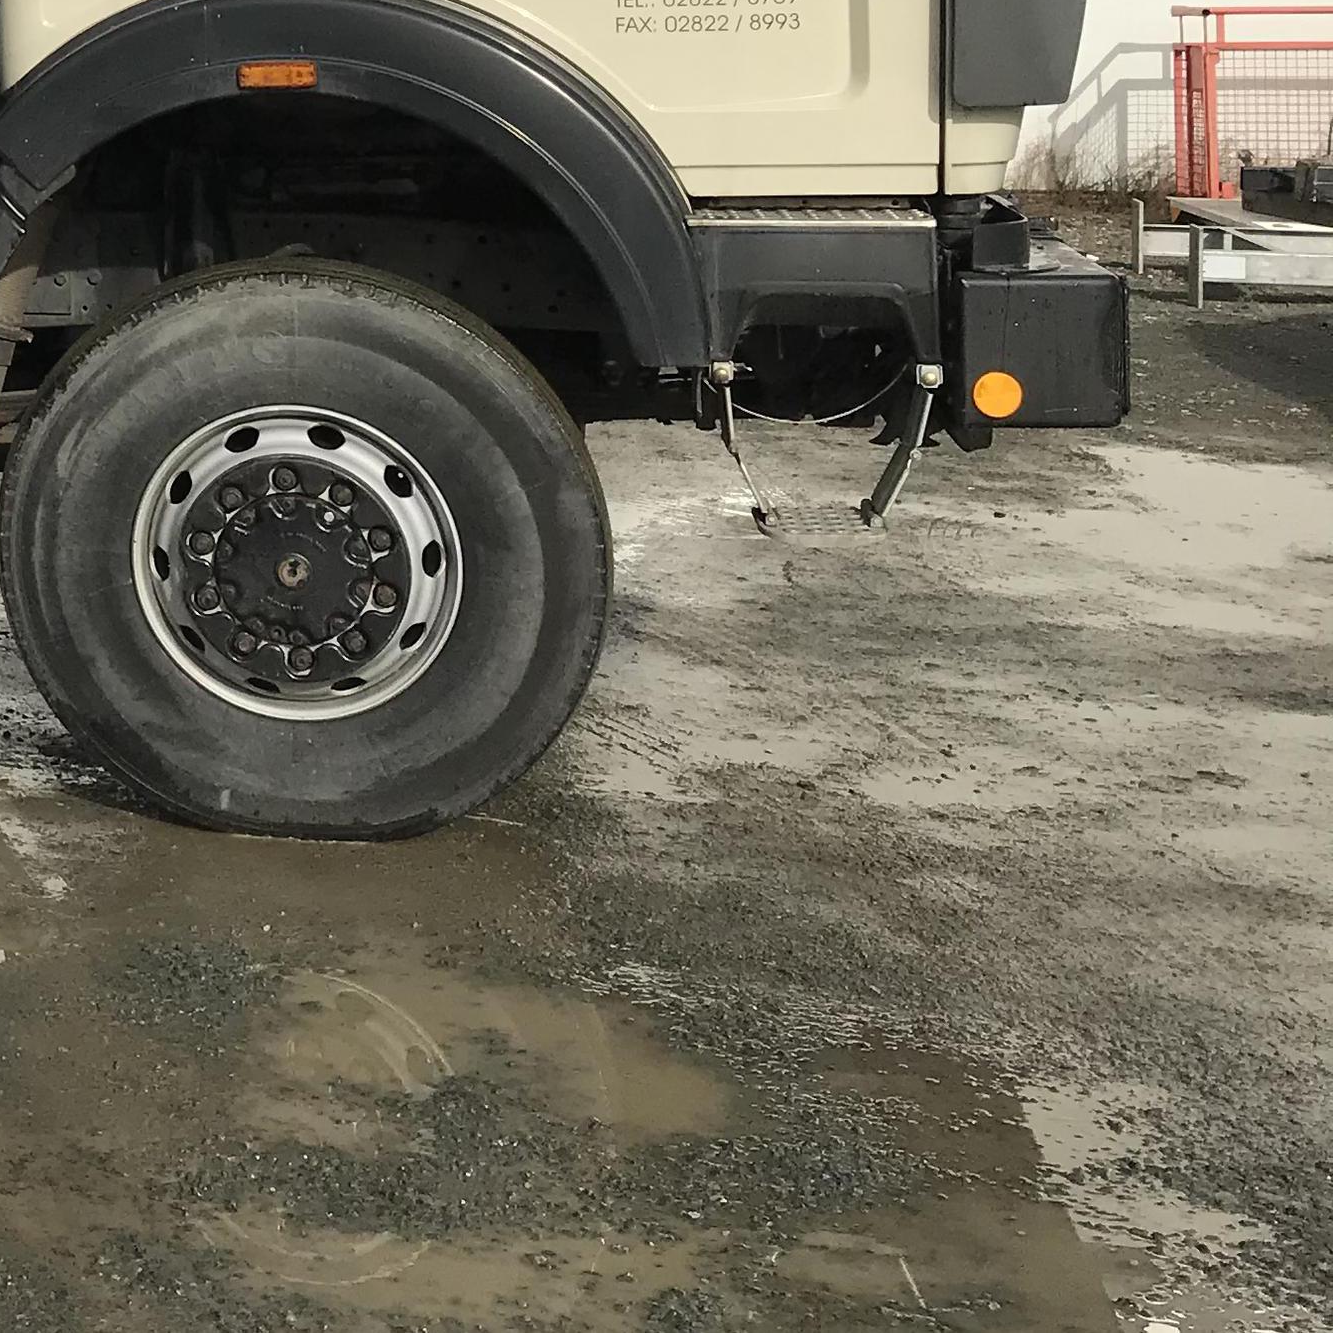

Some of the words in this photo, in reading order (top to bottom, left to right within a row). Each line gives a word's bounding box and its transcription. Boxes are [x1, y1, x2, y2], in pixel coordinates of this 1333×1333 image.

[615, 16, 657, 33] FAX:
[664, 14, 729, 33] 02822
[749, 12, 800, 31] 8993
